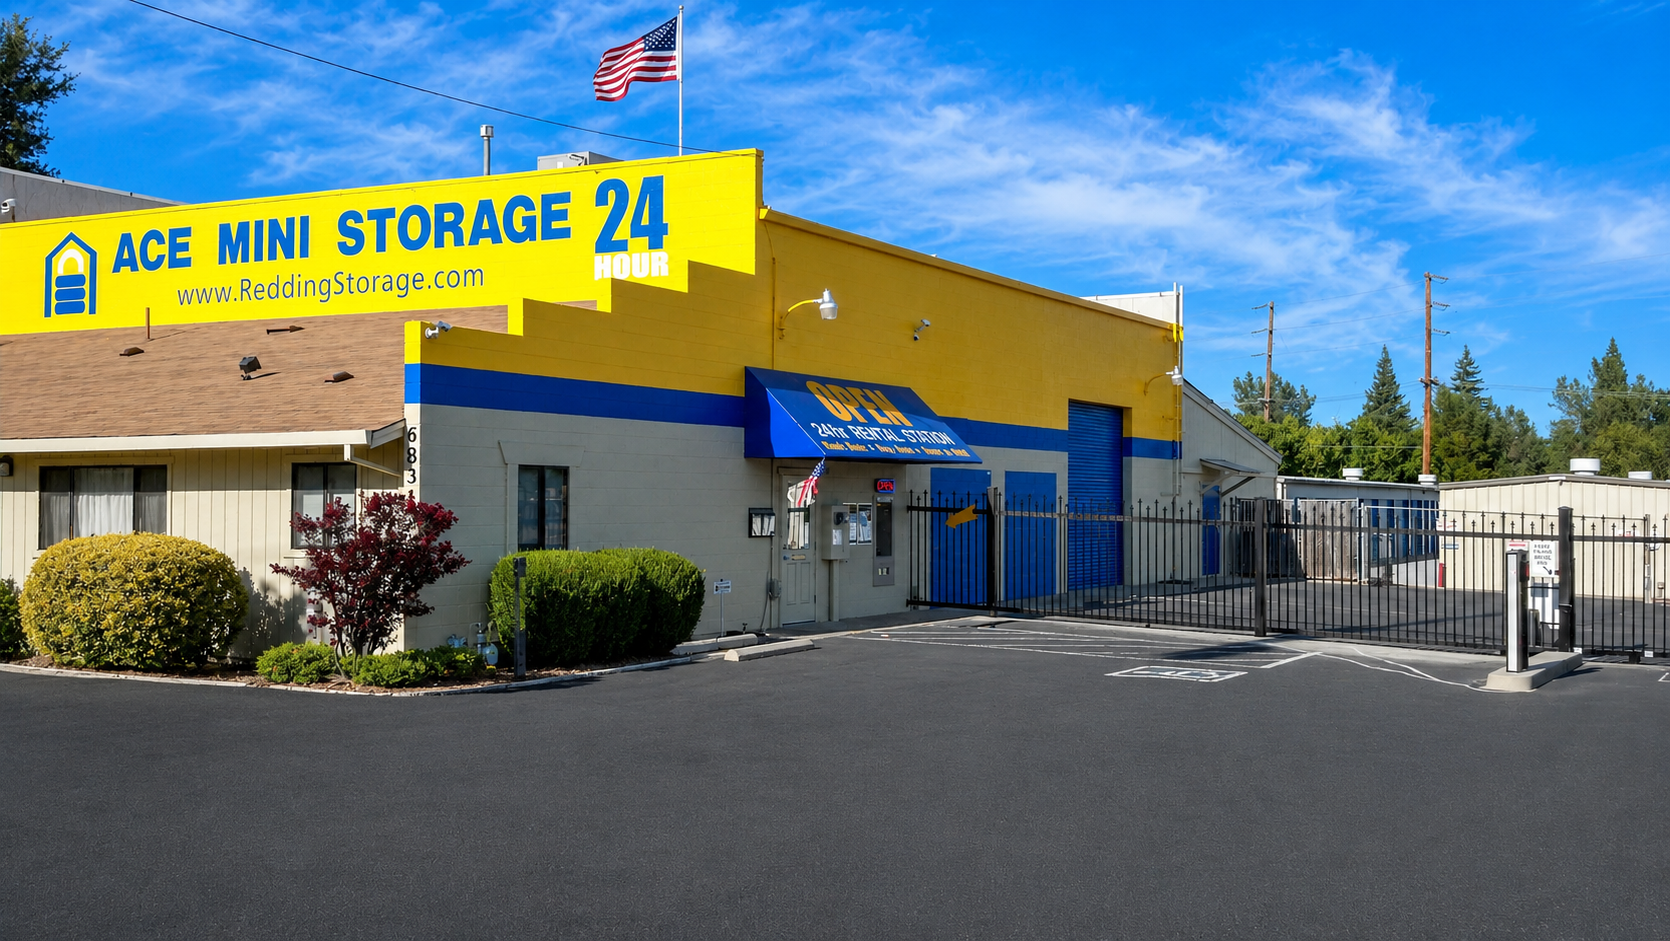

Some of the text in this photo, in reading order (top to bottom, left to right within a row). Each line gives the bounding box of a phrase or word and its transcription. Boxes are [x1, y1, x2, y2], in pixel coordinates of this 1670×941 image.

[112, 191, 571, 273] ACE MINI STORAGE
[595, 175, 669, 254] 24
[177, 267, 485, 306] www.ReddingStorage.com
[594, 251, 669, 280] HOUR
[806, 381, 913, 427] OPEN
[810, 422, 956, 446] 24hr RENTAL STATION
